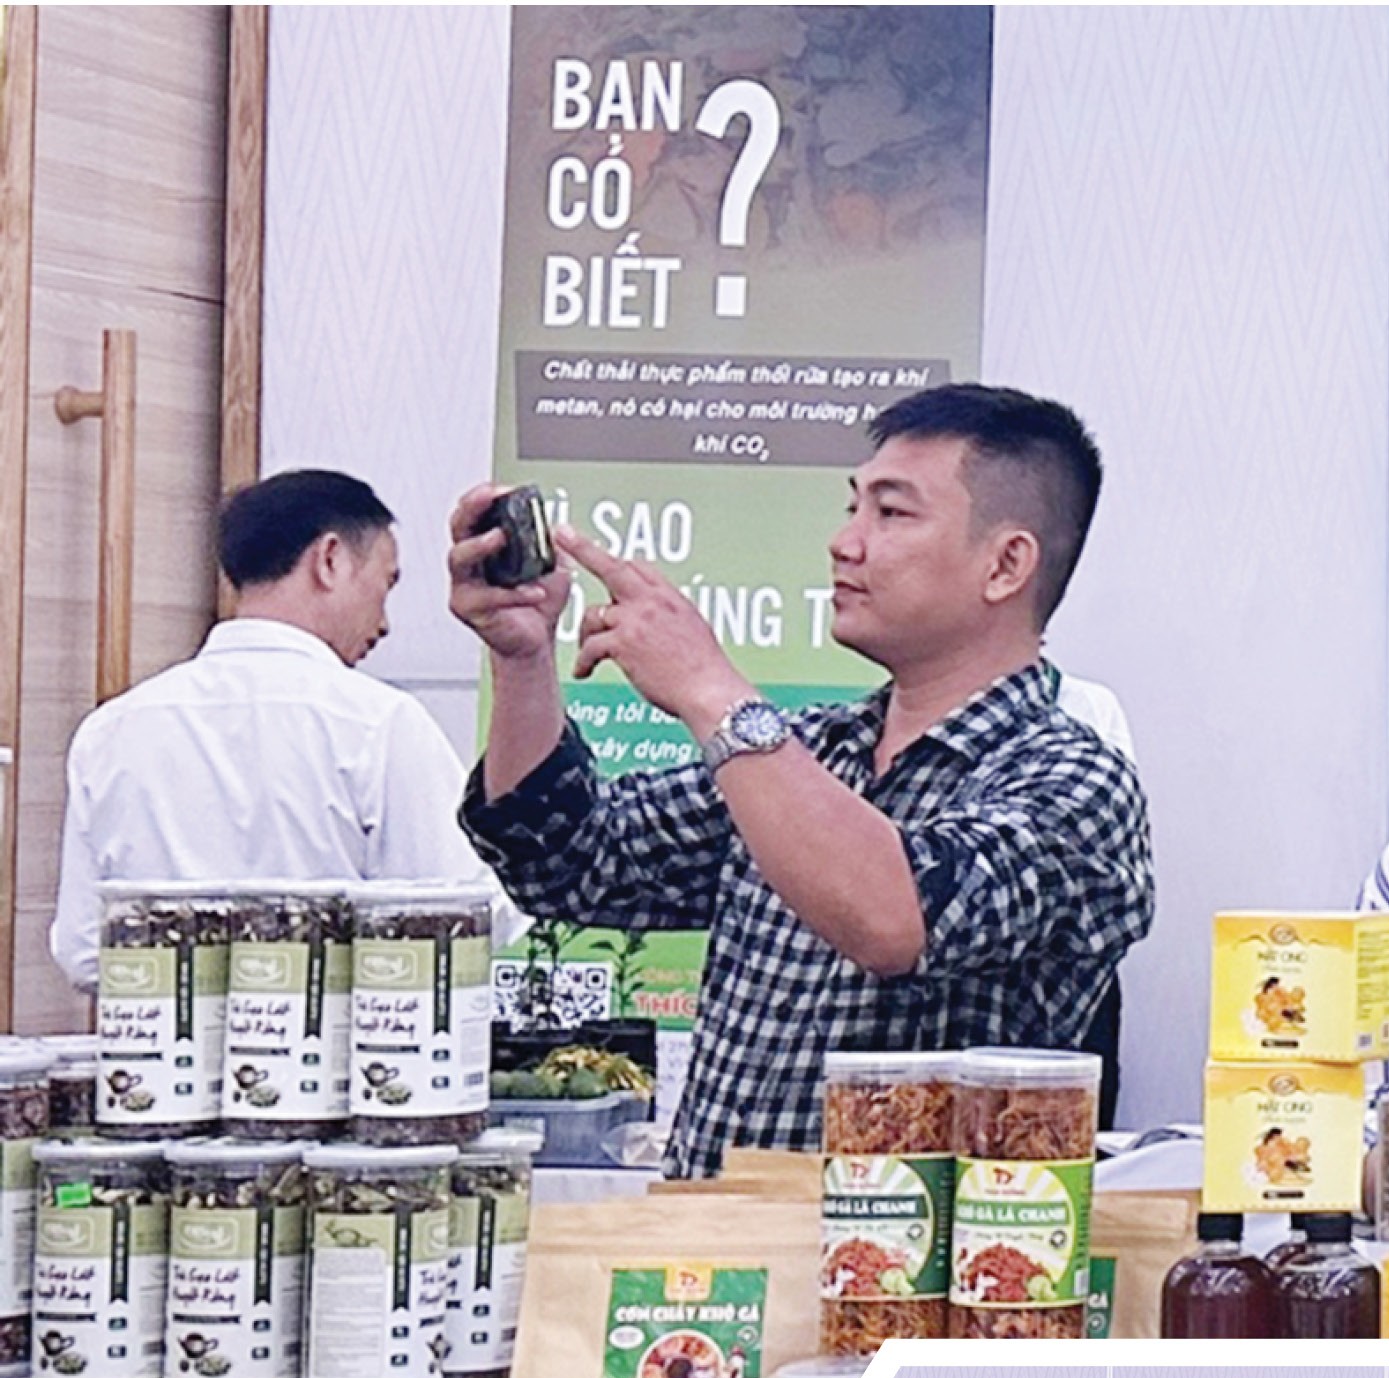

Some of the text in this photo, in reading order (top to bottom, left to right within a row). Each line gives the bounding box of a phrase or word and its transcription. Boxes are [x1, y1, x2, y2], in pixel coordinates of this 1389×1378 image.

[552, 59, 683, 143] BẠN
[548, 143, 631, 229] CÓ
[542, 232, 681, 328] BIẾT
[544, 360, 592, 380] Chất
[870, 372, 890, 386] ra
[537, 399, 603, 418] metan,
[640, 399, 666, 418] có
[670, 400, 700, 421] hại
[706, 400, 745, 420] cho
[694, 434, 728, 453] khí
[592, 502, 693, 563] SAO
[615, 702, 645, 723] tôi
